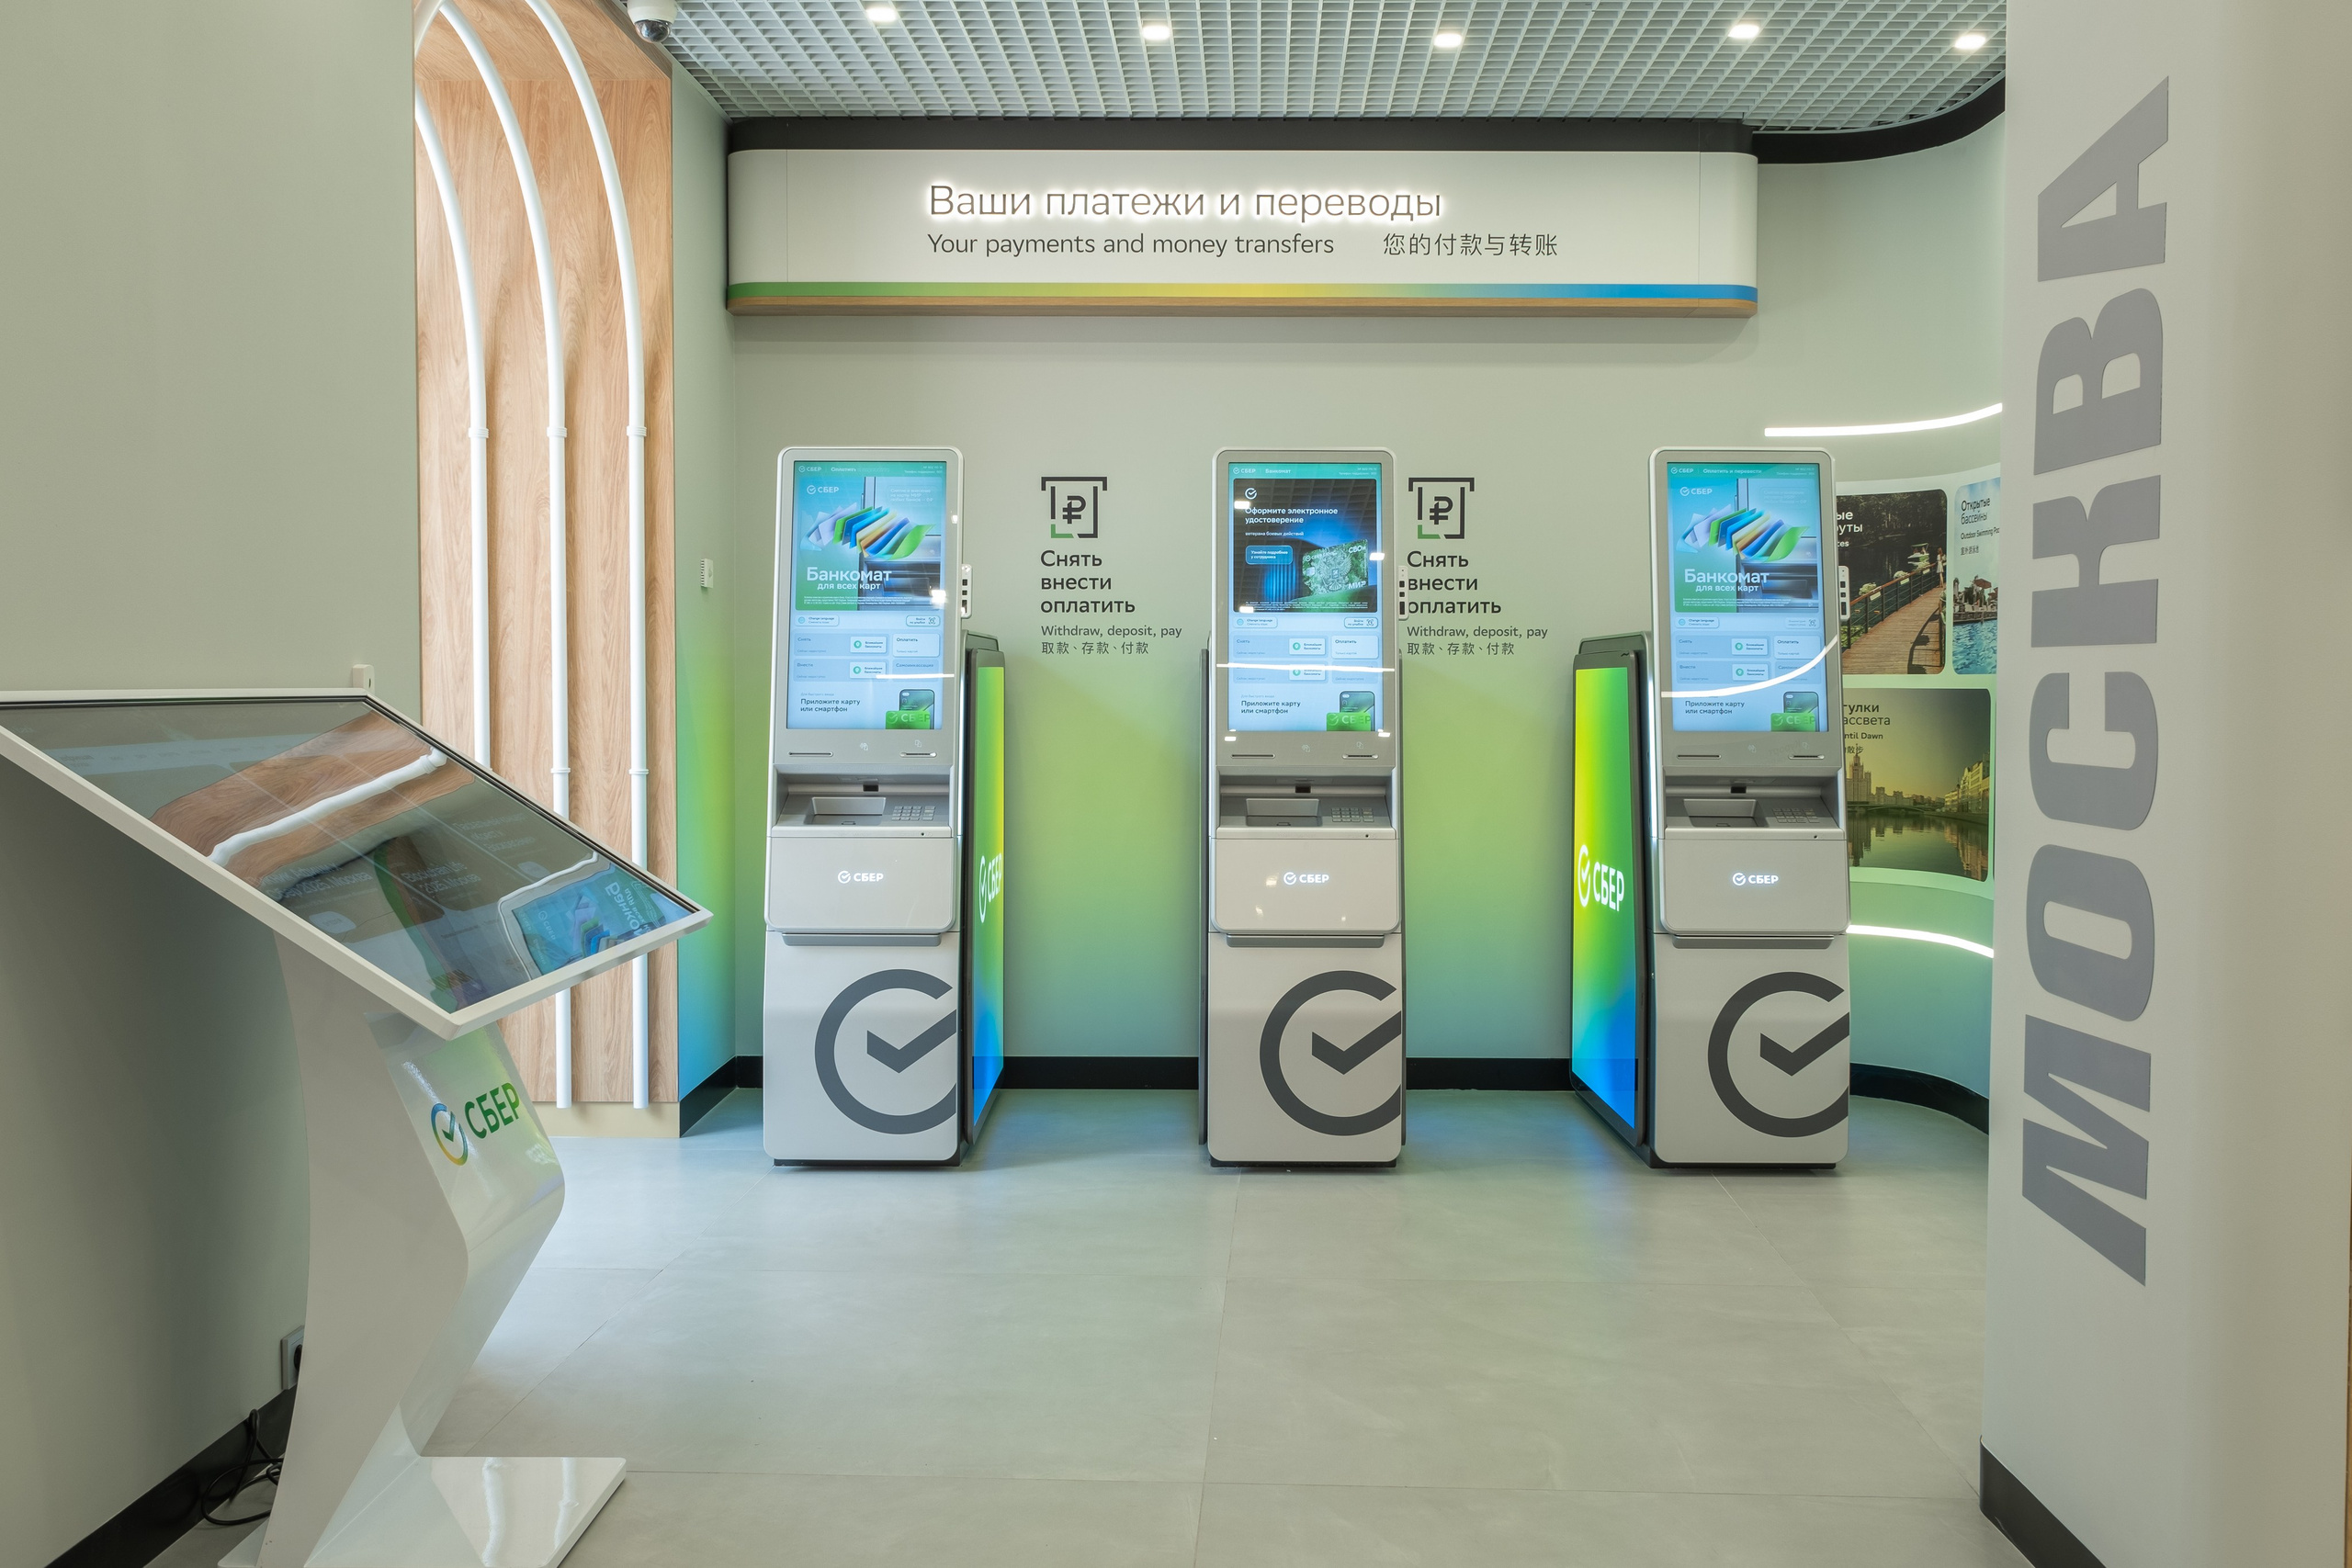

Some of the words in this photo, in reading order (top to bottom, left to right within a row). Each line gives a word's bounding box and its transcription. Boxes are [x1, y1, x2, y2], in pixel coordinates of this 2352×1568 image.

[930, 185, 1031, 216] Ваши
[1046, 192, 1204, 216] платежи
[1220, 193, 1240, 216] и
[1255, 193, 1441, 223] переводы
[927, 233, 978, 254] Your
[985, 235, 1095, 258] payments
[1102, 232, 1145, 254] and
[1153, 238, 1228, 258] money
[1234, 232, 1335, 254] transfers
[1383, 232, 1558, 256] 您的付款与转账
[817, 486, 840, 494] СБЕР
[1961, 498, 1991, 512] Открытые
[1961, 511, 1987, 525] бассейны
[1960, 532, 1976, 540] Outdoor
[1040, 550, 1102, 567] Снять
[1407, 550, 1469, 568] Снять
[807, 567, 893, 581] Банкомат
[1684, 569, 1770, 583] Банкомат
[817, 582, 835, 591] для
[1041, 577, 1112, 590] внести
[1408, 578, 1478, 591] внести
[1040, 601, 1136, 613] оплатить
[1408, 601, 1502, 614] оплатить
[1041, 625, 1103, 637] Withdraw,
[1107, 625, 1157, 638] deposit,
[1160, 627, 1182, 638] pay
[1407, 626, 1469, 638] Withdraw,
[1473, 626, 1522, 639] deposit,
[1526, 628, 1548, 639] pay
[1041, 641, 1148, 655] 取款、存款、付款
[1407, 642, 1514, 655] 取款、存款、付款
[2021, 75, 2169, 1287] МОСКВА
[328, 873, 373, 888] Москва
[854, 872, 885, 883] СБЕР
[988, 852, 1002, 903] СБЕР
[1298, 873, 1330, 884] СБЕР
[1747, 874, 1780, 885] СБЕР
[1593, 861, 1625, 912] СБЕР
[464, 1082, 520, 1139] СБЕР
